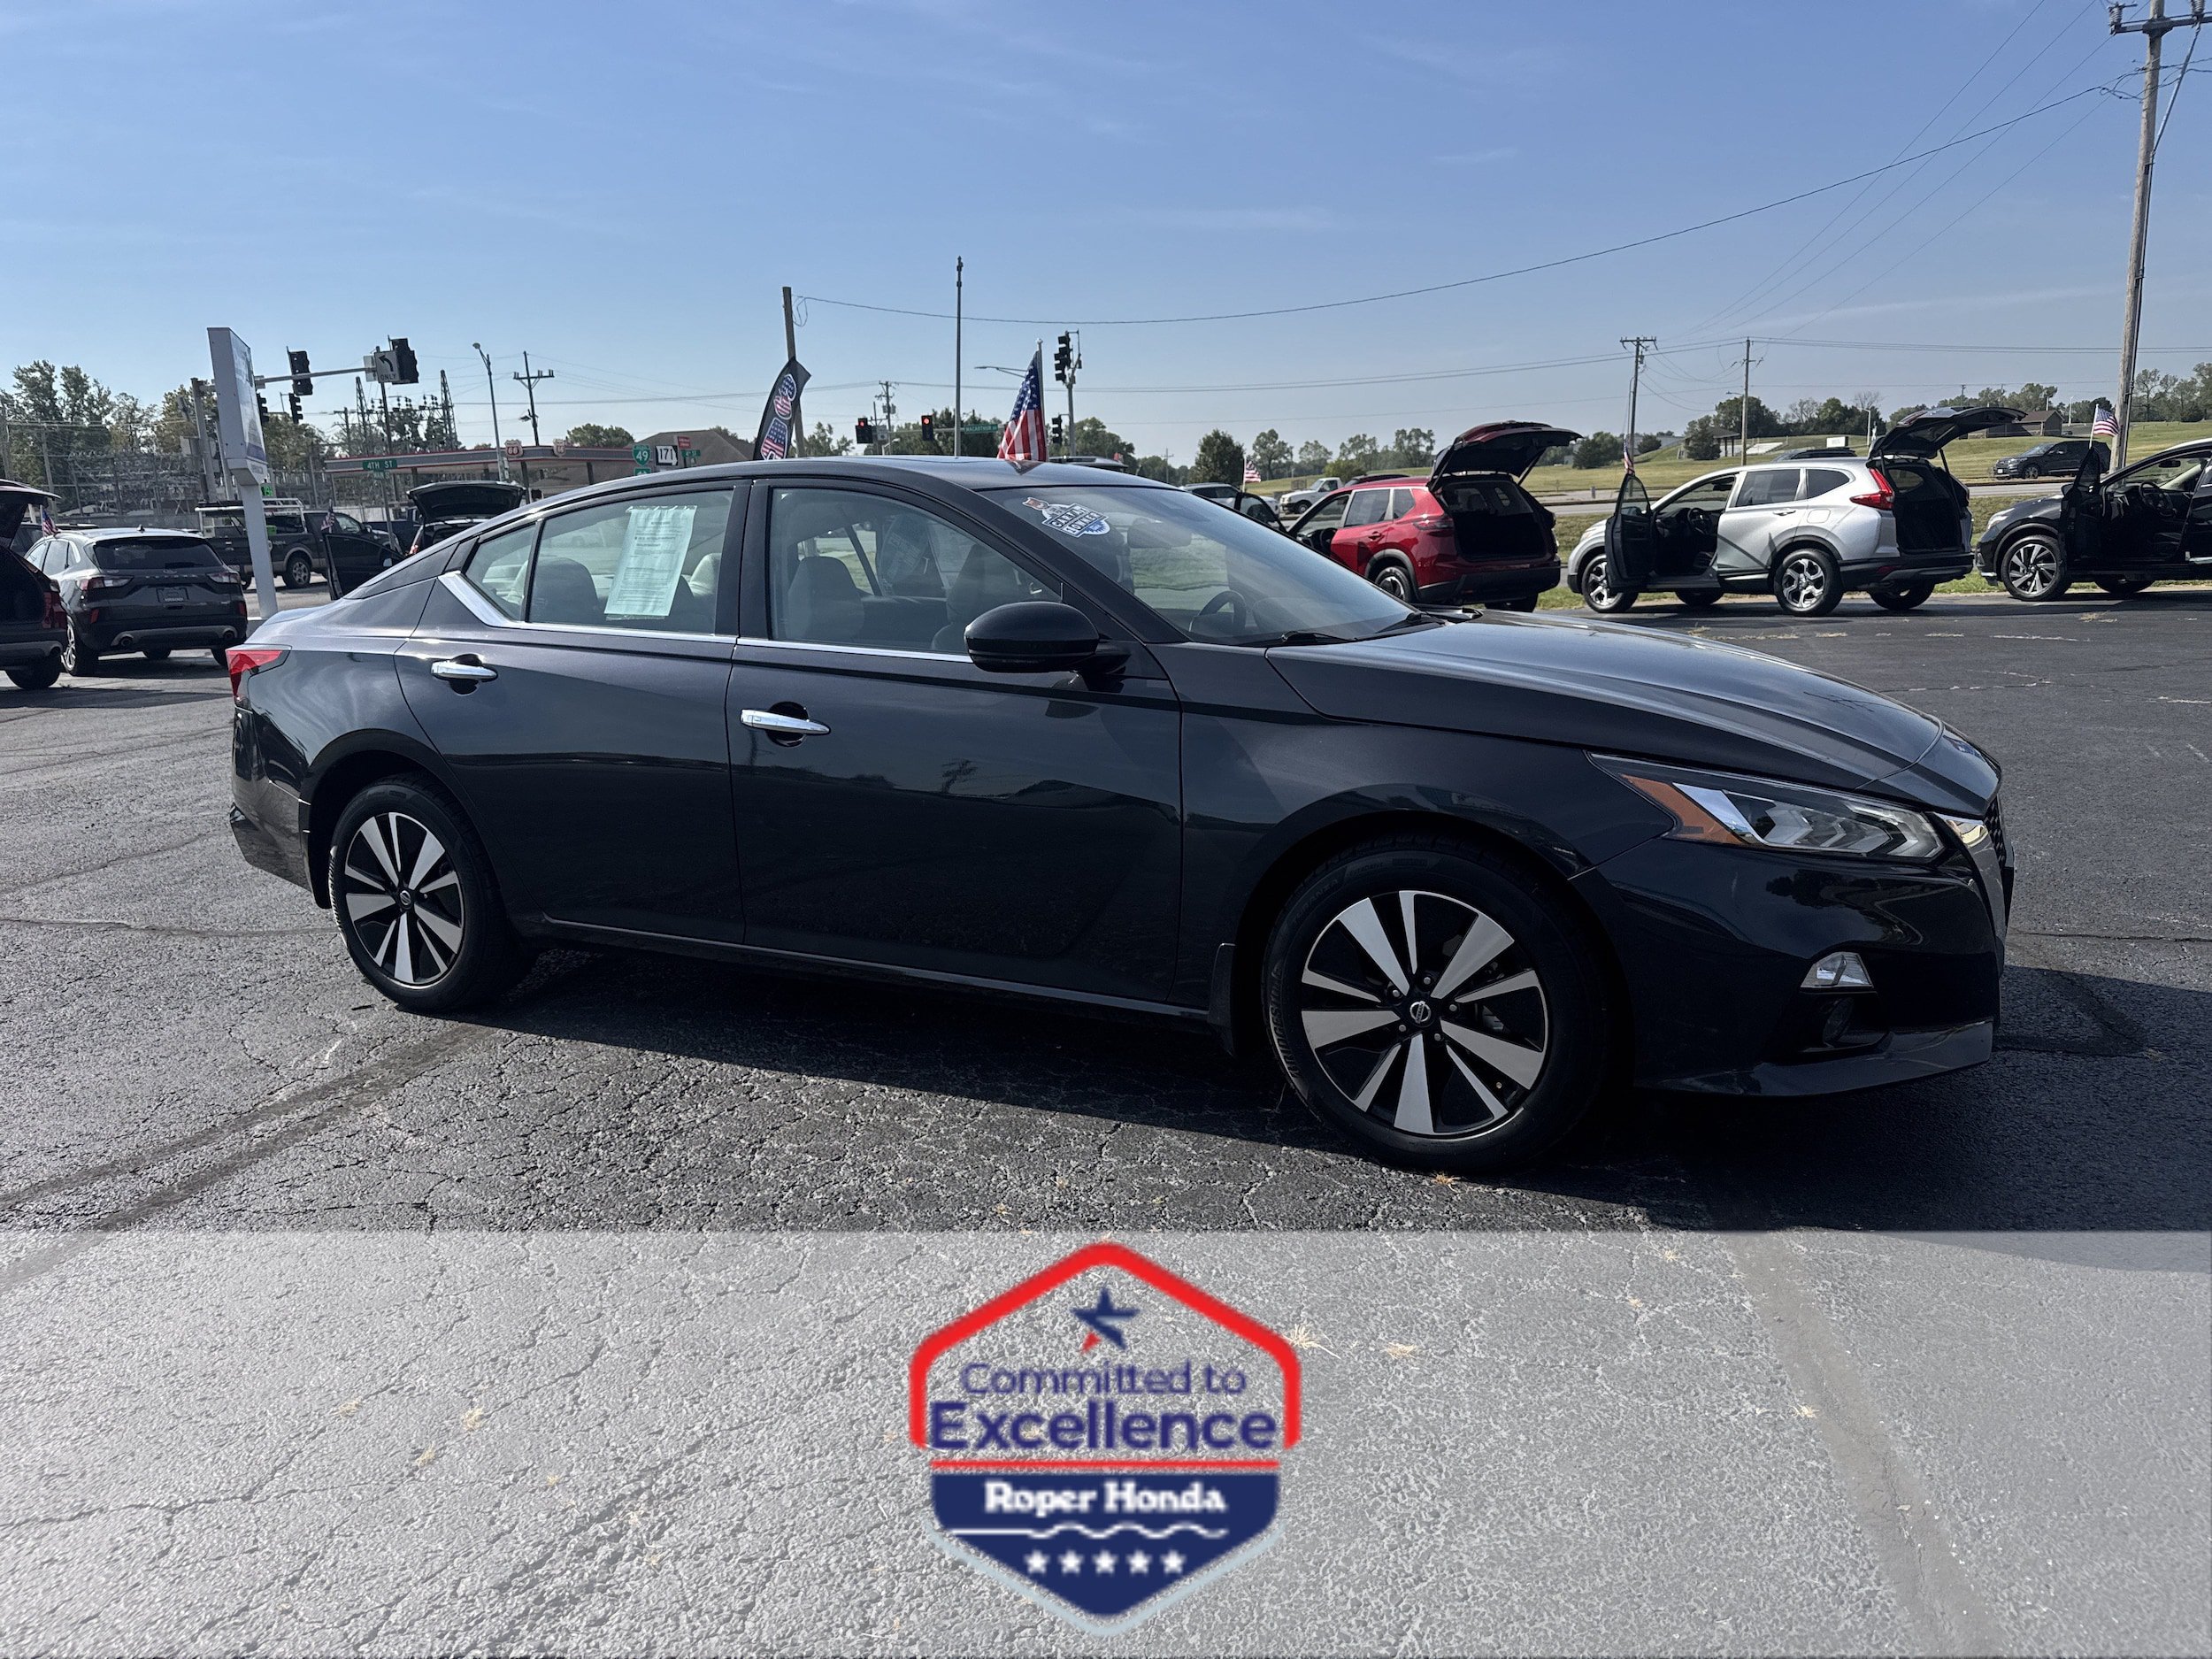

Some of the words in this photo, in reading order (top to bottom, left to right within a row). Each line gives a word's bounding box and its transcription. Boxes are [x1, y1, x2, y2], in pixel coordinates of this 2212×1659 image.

[635, 450, 649, 461] 49
[659, 448, 673, 460] 171
[367, 461, 380, 470] 4TH
[384, 460, 394, 469] ST
